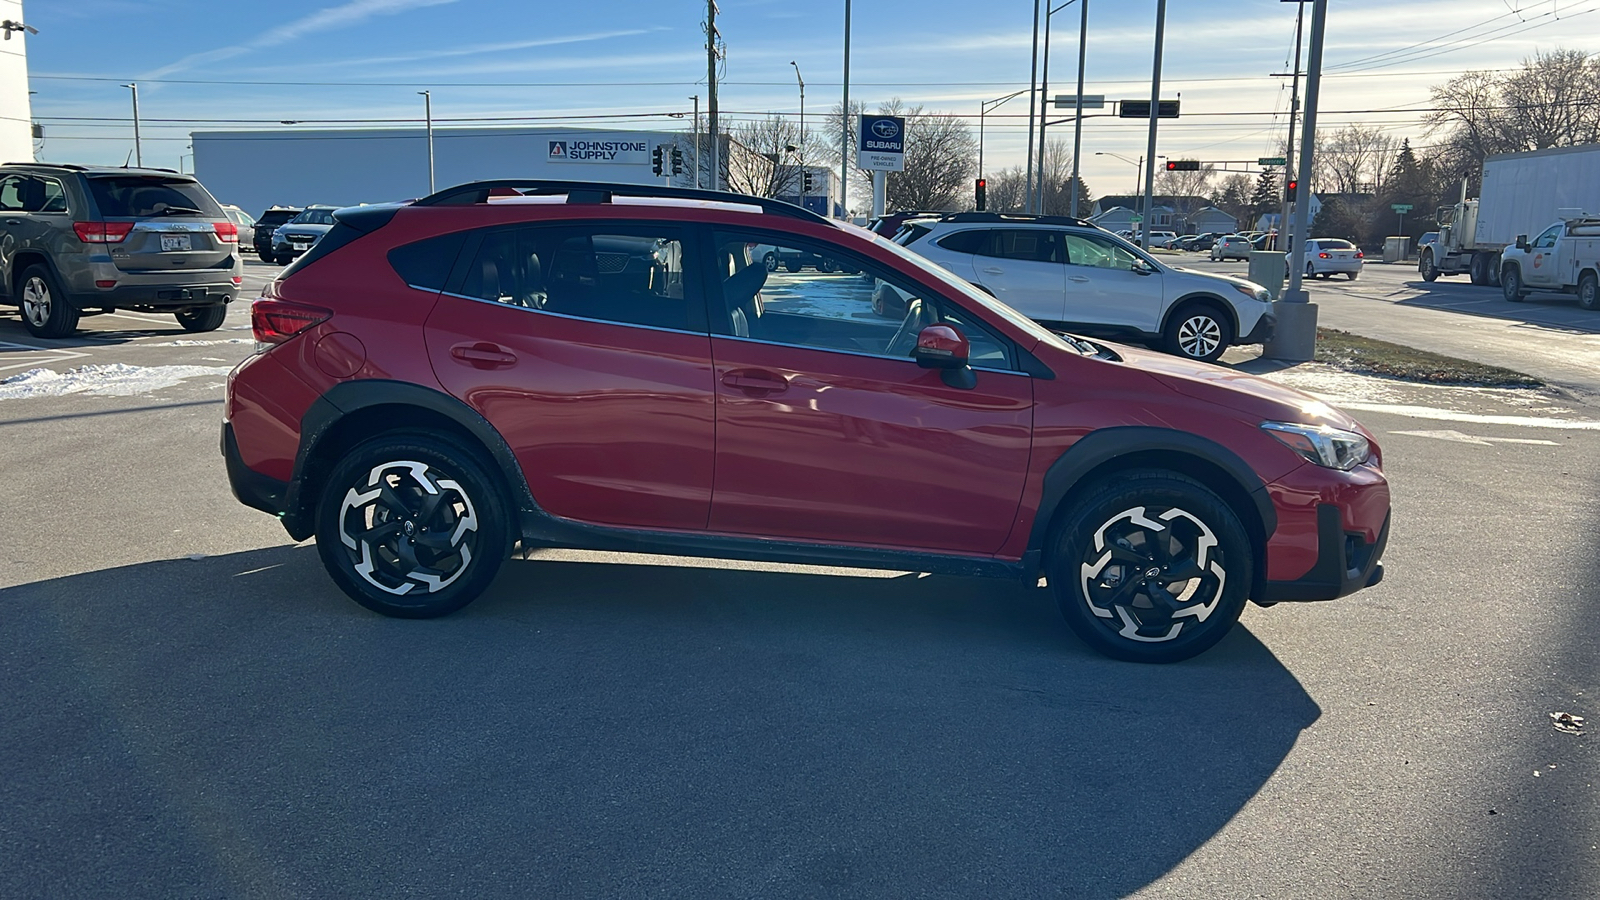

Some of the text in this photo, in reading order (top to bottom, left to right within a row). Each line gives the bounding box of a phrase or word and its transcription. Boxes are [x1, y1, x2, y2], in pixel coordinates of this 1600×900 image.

[569, 141, 646, 152] JOHNSTONE
[867, 141, 901, 150] SUBARU
[569, 151, 617, 160] SUPPLY
